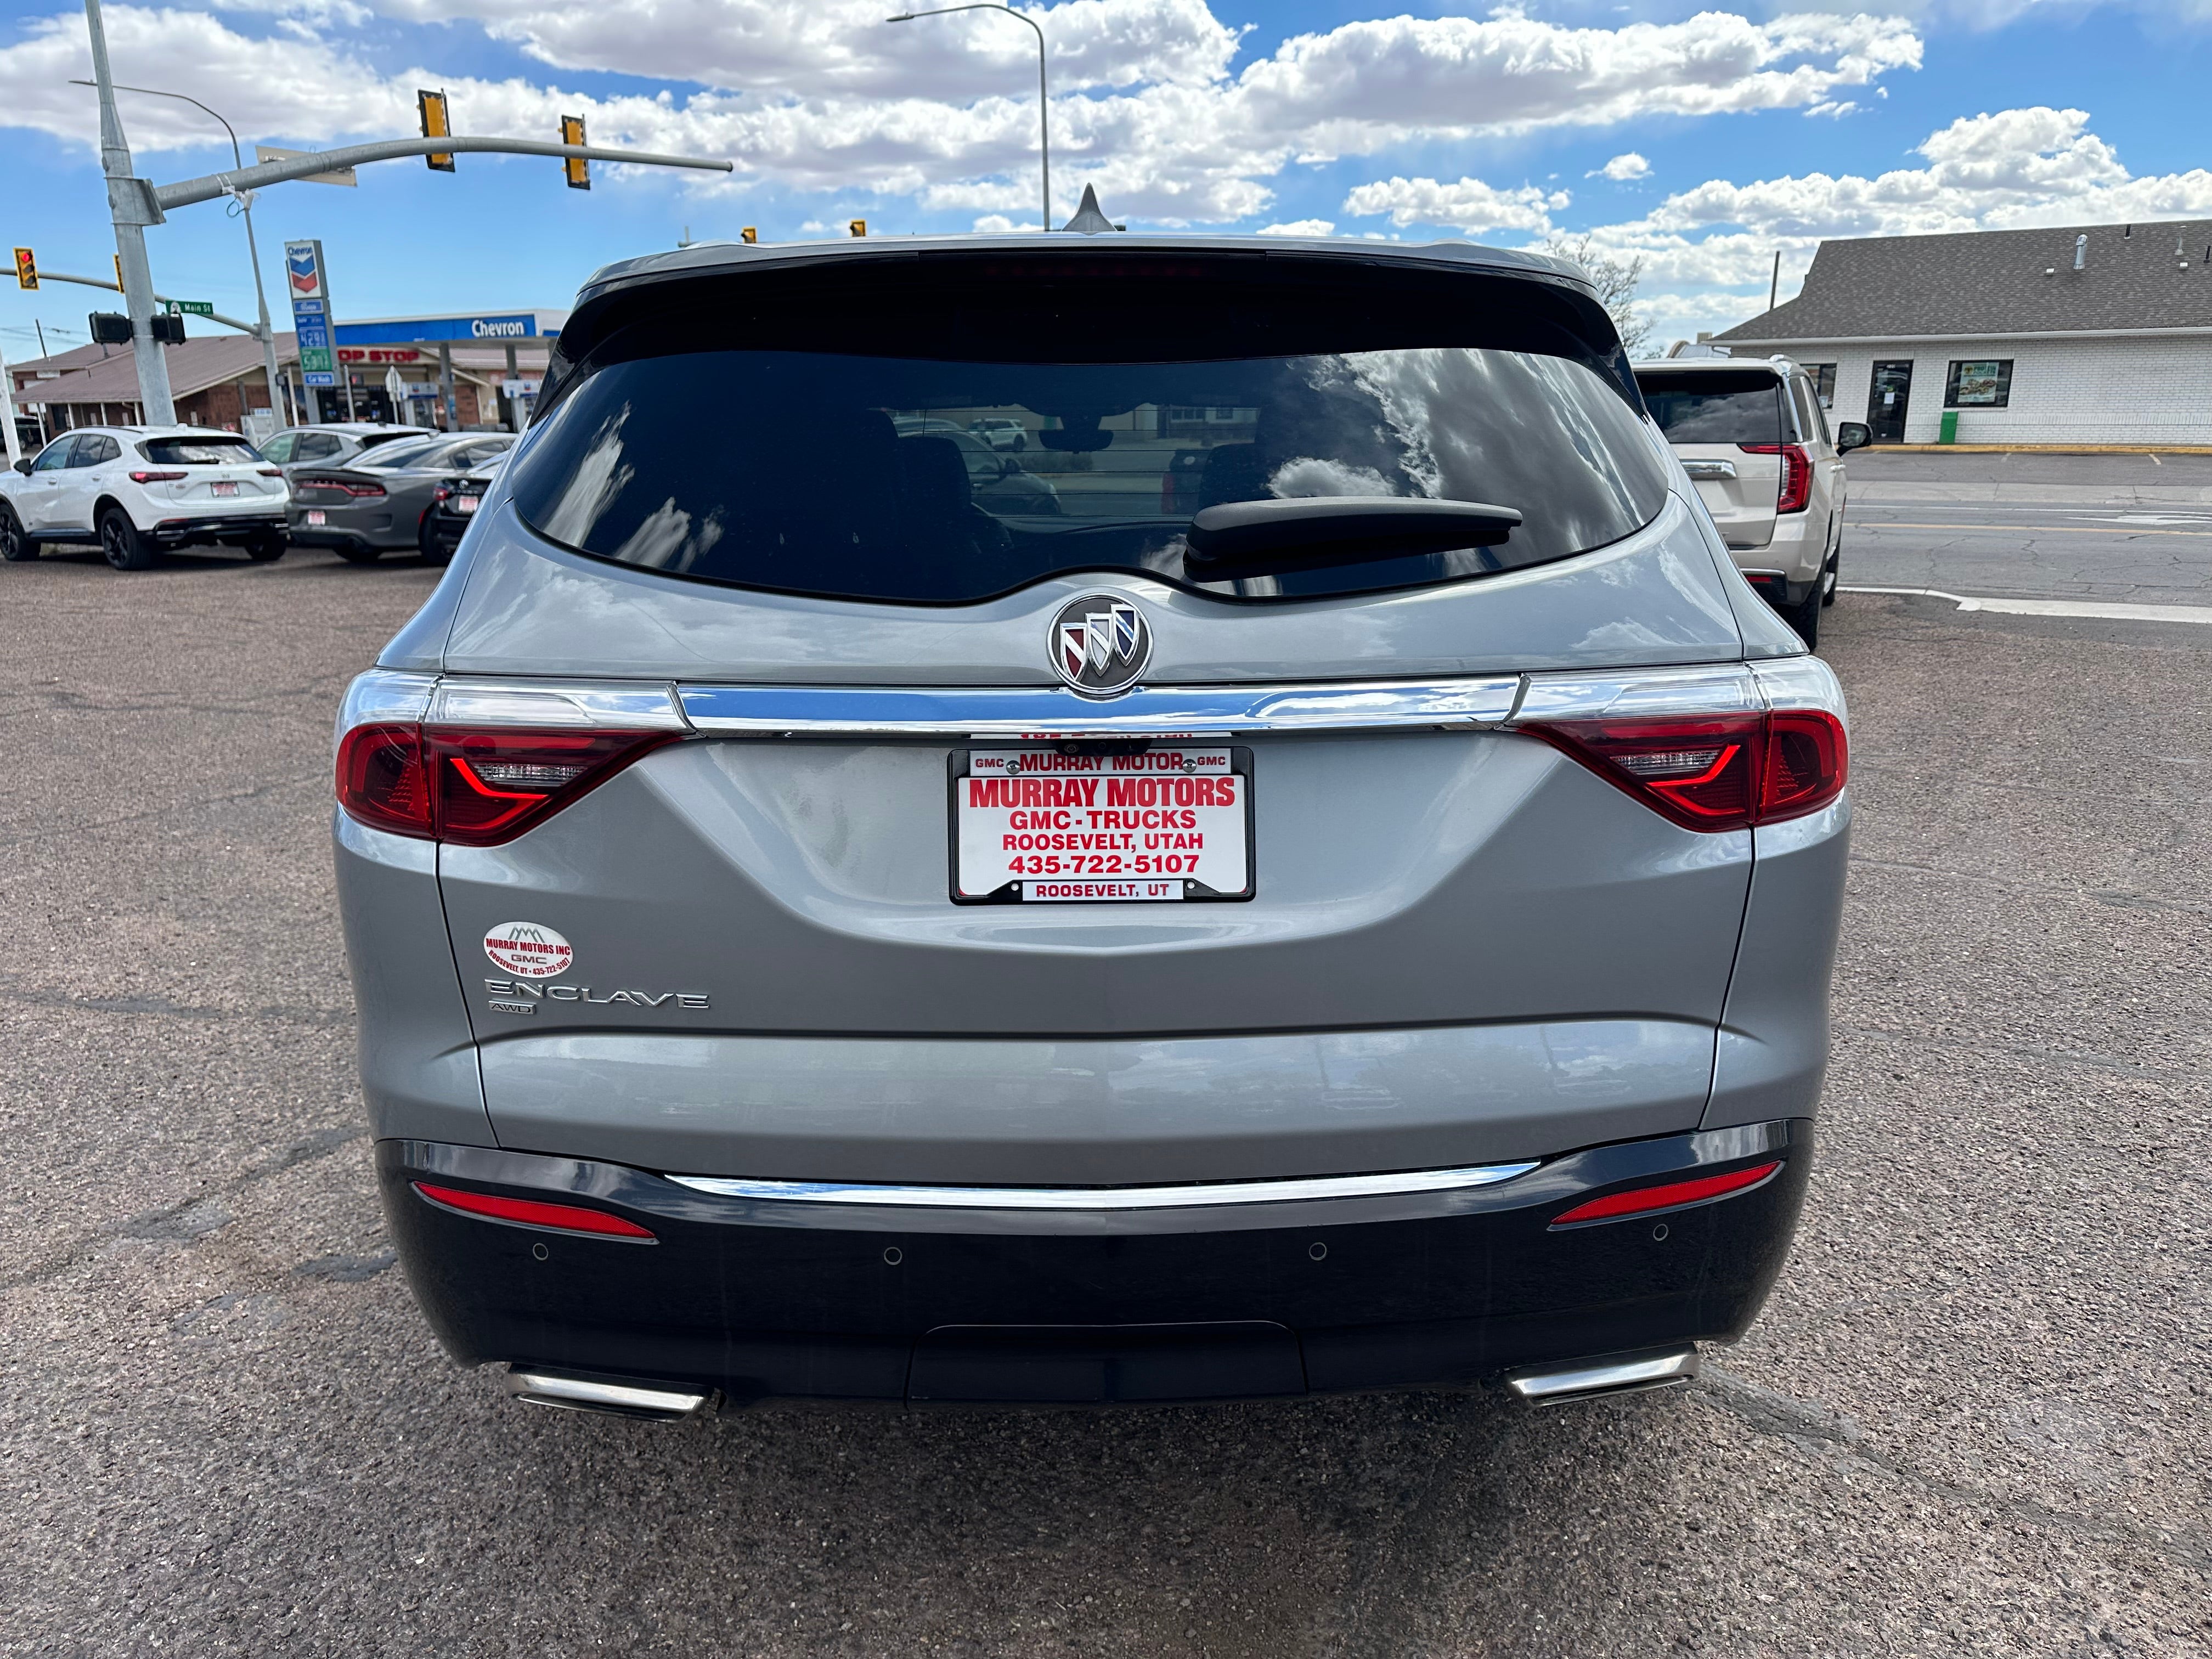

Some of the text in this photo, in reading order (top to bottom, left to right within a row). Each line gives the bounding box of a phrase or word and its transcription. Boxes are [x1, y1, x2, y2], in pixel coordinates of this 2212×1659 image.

[185, 303, 201, 312] Main
[203, 304, 211, 313] St
[472, 319, 524, 337] Chevron
[338, 350, 419, 362] OP STOP
[975, 753, 1226, 771] GMC MURRAY MOTOR GMC
[969, 777, 1235, 808] MURRAY MOTORS
[1003, 833, 1203, 853] ROOSEVELT, UTAH
[1008, 855, 1199, 874] 435-722-5107
[1036, 884, 1169, 897] ROOSEVELT, UT
[486, 938, 571, 956] MURRAY MOTORS INC
[488, 950, 519, 973] ROOSEVELT,
[533, 957, 571, 975] 435-722-5107
[511, 954, 547, 964] GMC
[484, 978, 710, 1009] ENCLAVE
[491, 1003, 531, 1013] AWD
